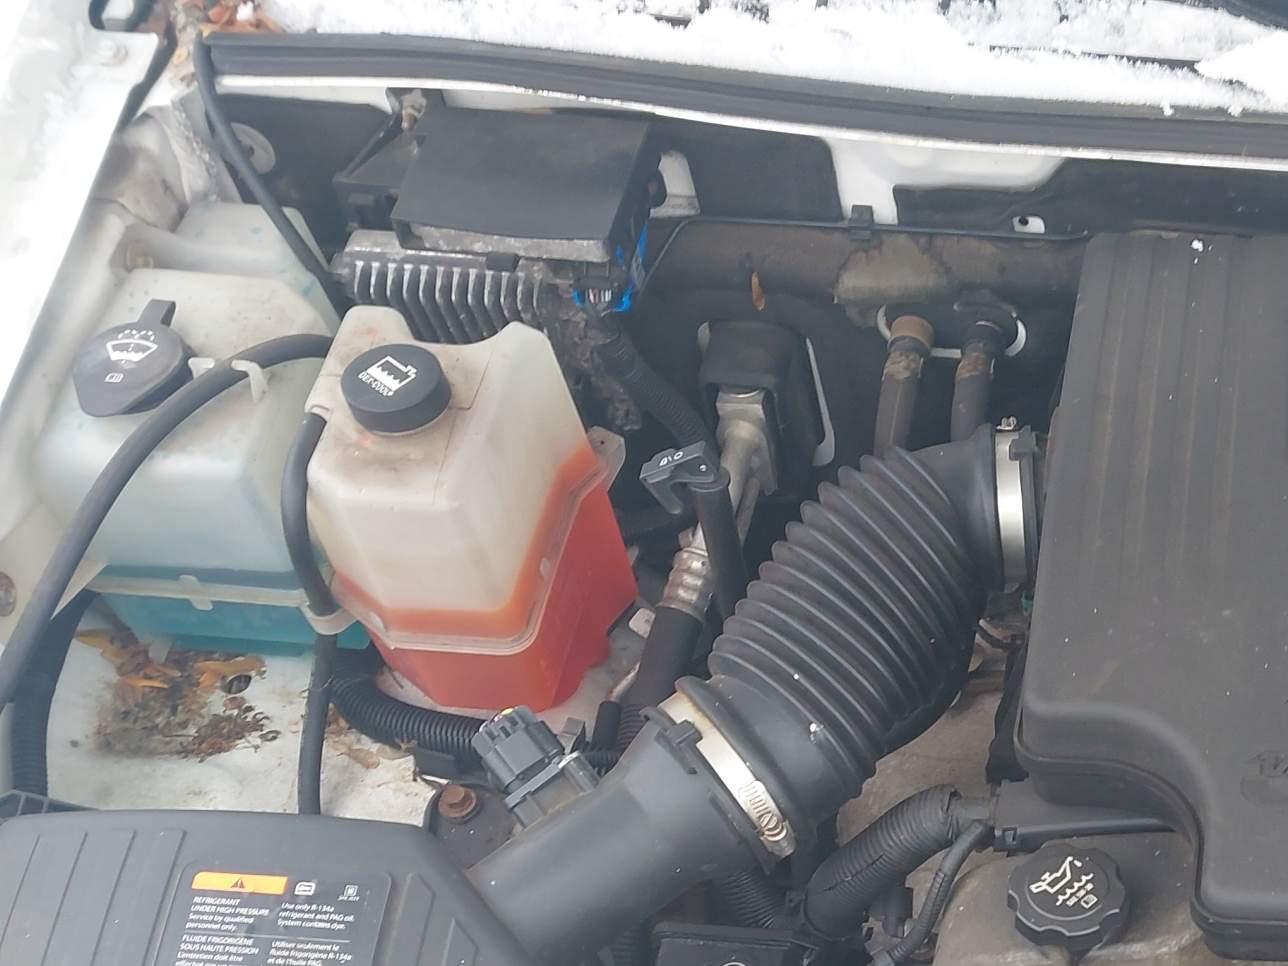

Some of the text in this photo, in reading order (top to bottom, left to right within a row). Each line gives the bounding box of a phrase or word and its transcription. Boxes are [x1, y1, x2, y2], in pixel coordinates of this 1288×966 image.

[192, 896, 240, 906] REFRIGERANT
[191, 904, 270, 917] UNDER HIGH PRESSURE
[295, 903, 311, 912] only
[188, 913, 255, 924] Service by qualified
[279, 911, 316, 920] refrigerant
[315, 912, 330, 921] and
[329, 913, 344, 922] PAG
[185, 921, 220, 930] personnel
[277, 918, 301, 928] System
[302, 920, 331, 929] contains
[182, 934, 208, 943] FLUIDE
[180, 942, 260, 955] SOUS HAUTE PRESSION
